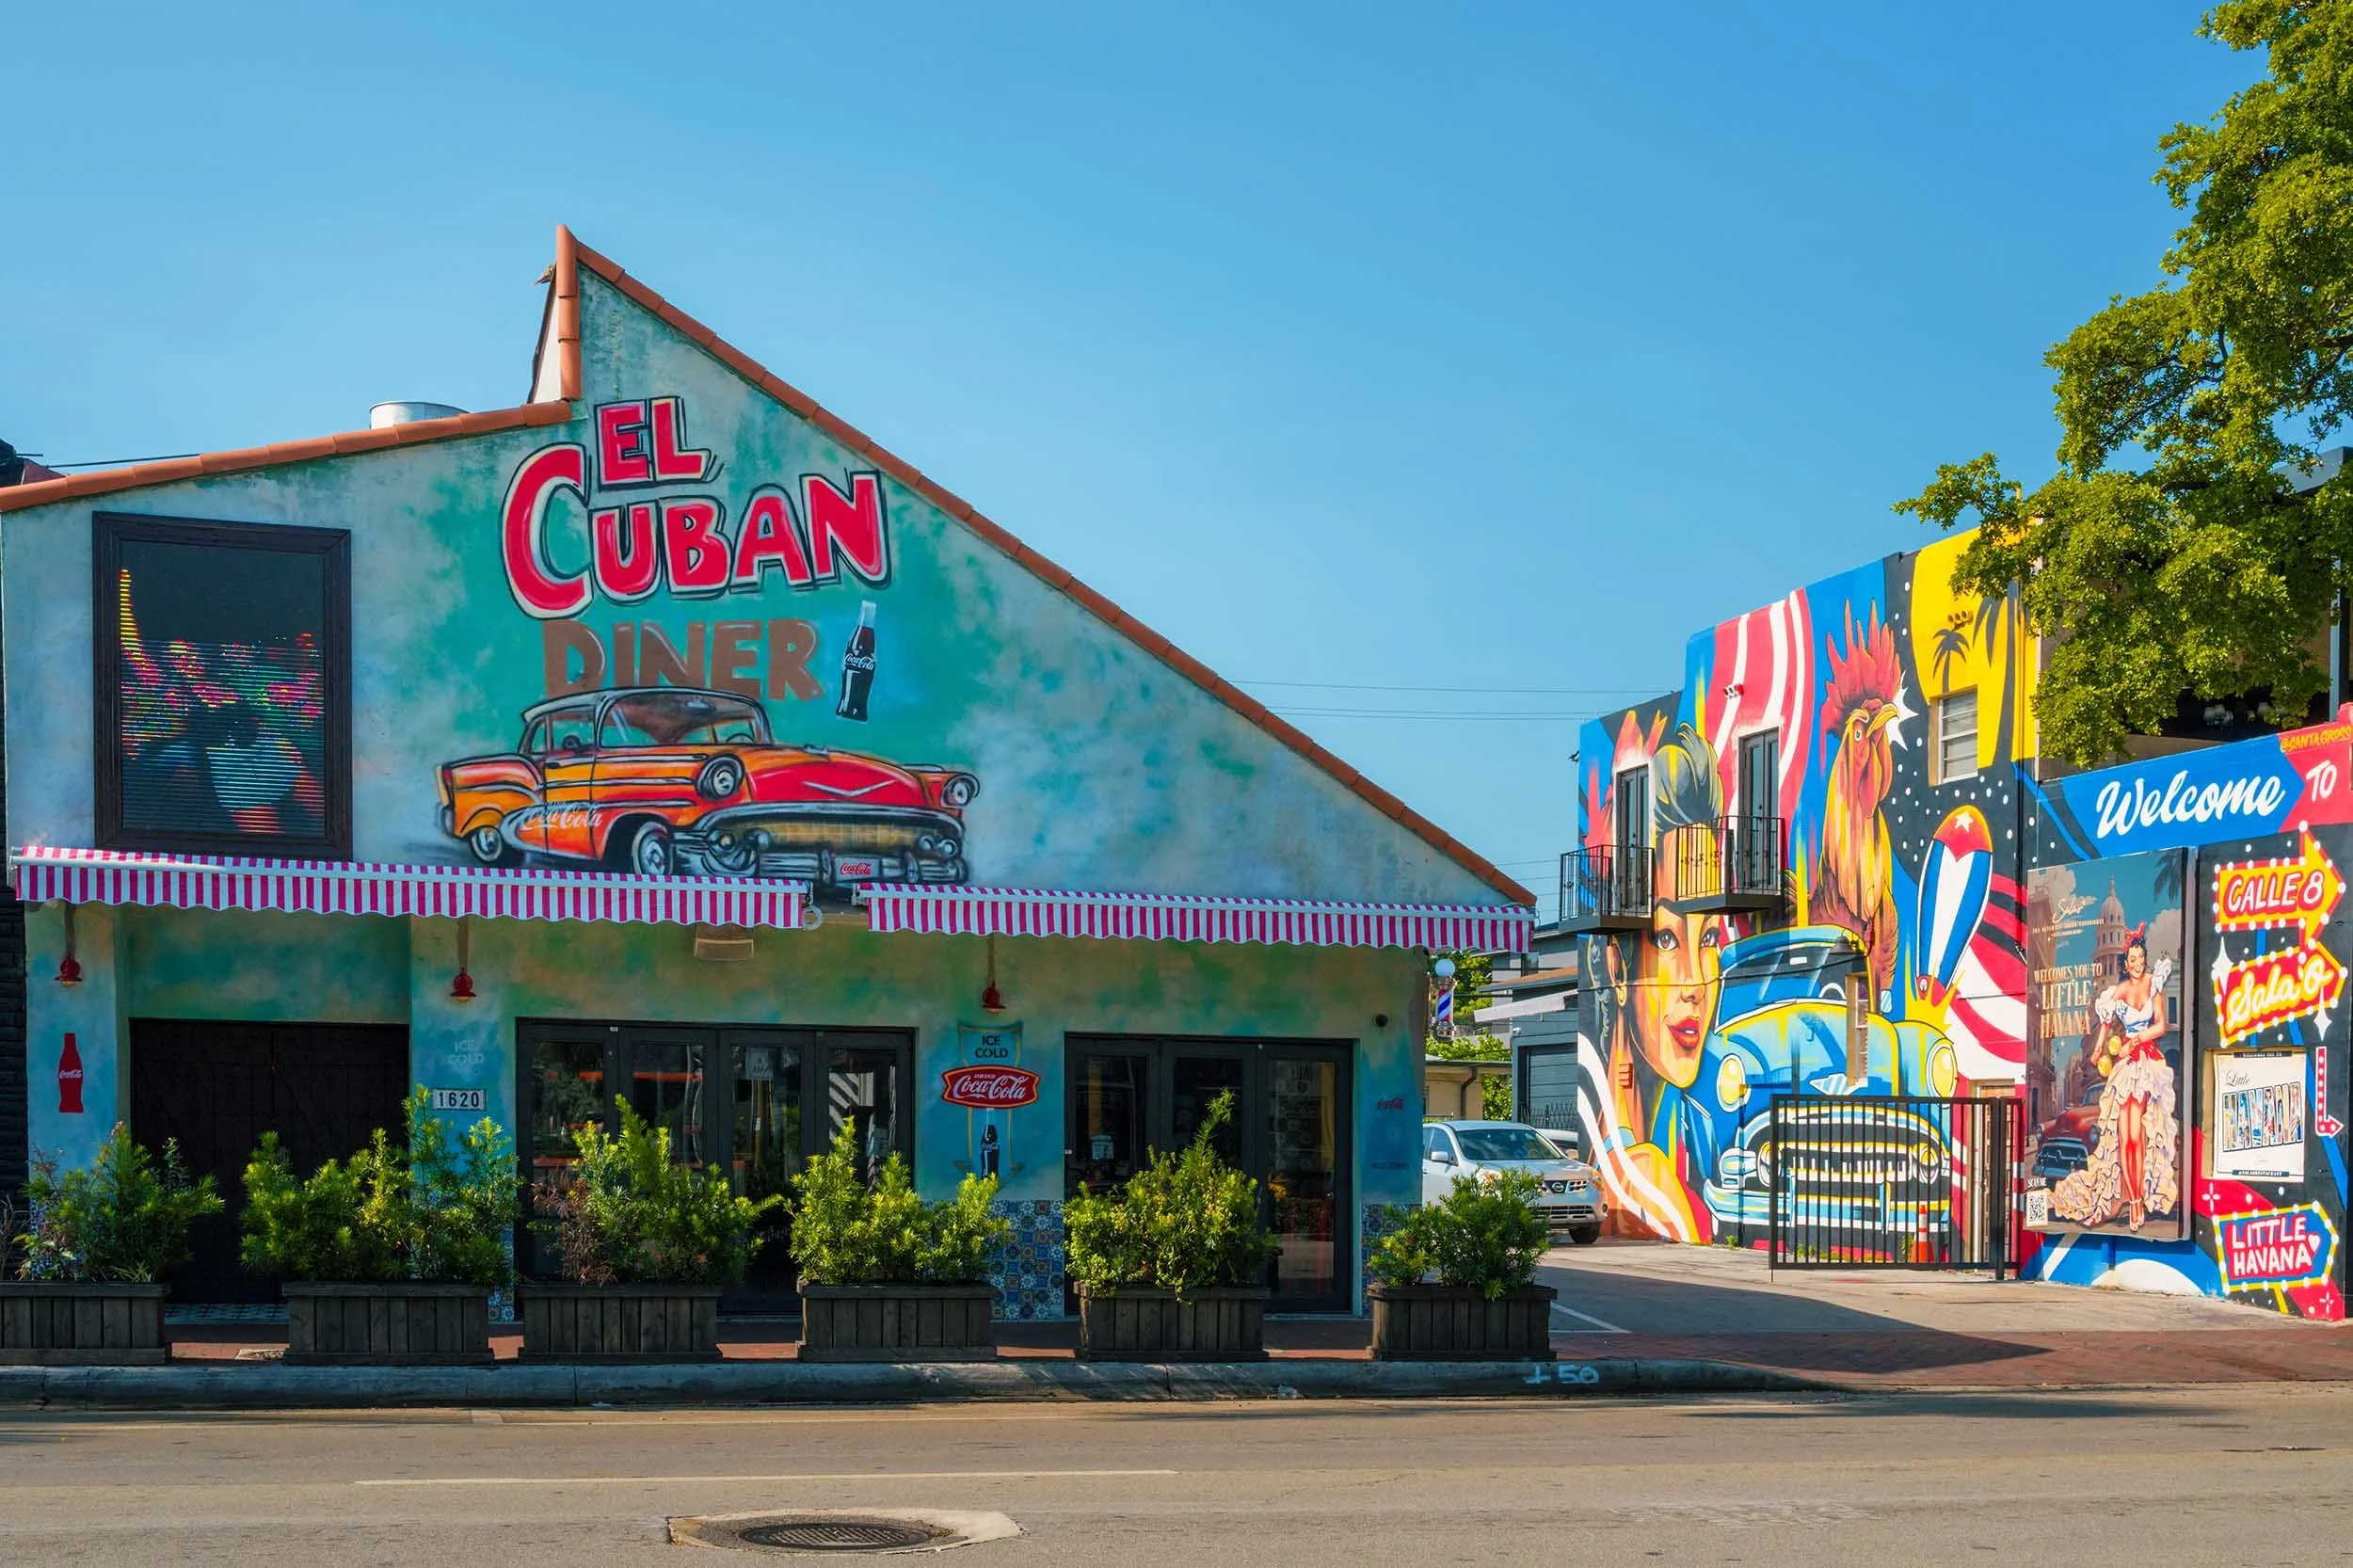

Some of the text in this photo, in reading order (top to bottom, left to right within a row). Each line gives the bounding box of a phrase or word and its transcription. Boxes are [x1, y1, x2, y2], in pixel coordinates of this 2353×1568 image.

[595, 396, 715, 491] EL
[502, 442, 891, 619] CUBAN
[542, 617, 825, 701] DINER
[2096, 760, 2337, 839] Welcome TO
[2227, 871, 2325, 912] CALLE 8
[2034, 962, 2103, 984] WELCOMES YOU TO
[2041, 980, 2092, 1010] LITTLE
[982, 1034, 1001, 1046] ICE
[2040, 1009, 2091, 1039] HAVANA
[974, 1048, 1009, 1059] COLD
[2226, 1068, 2250, 1087] Little
[438, 1092, 480, 1108] 1620
[2222, 1081, 2303, 1152] HAVANA
[2232, 1216, 2307, 1250] LITTLE
[2233, 1242, 2313, 1277] HAVANA
